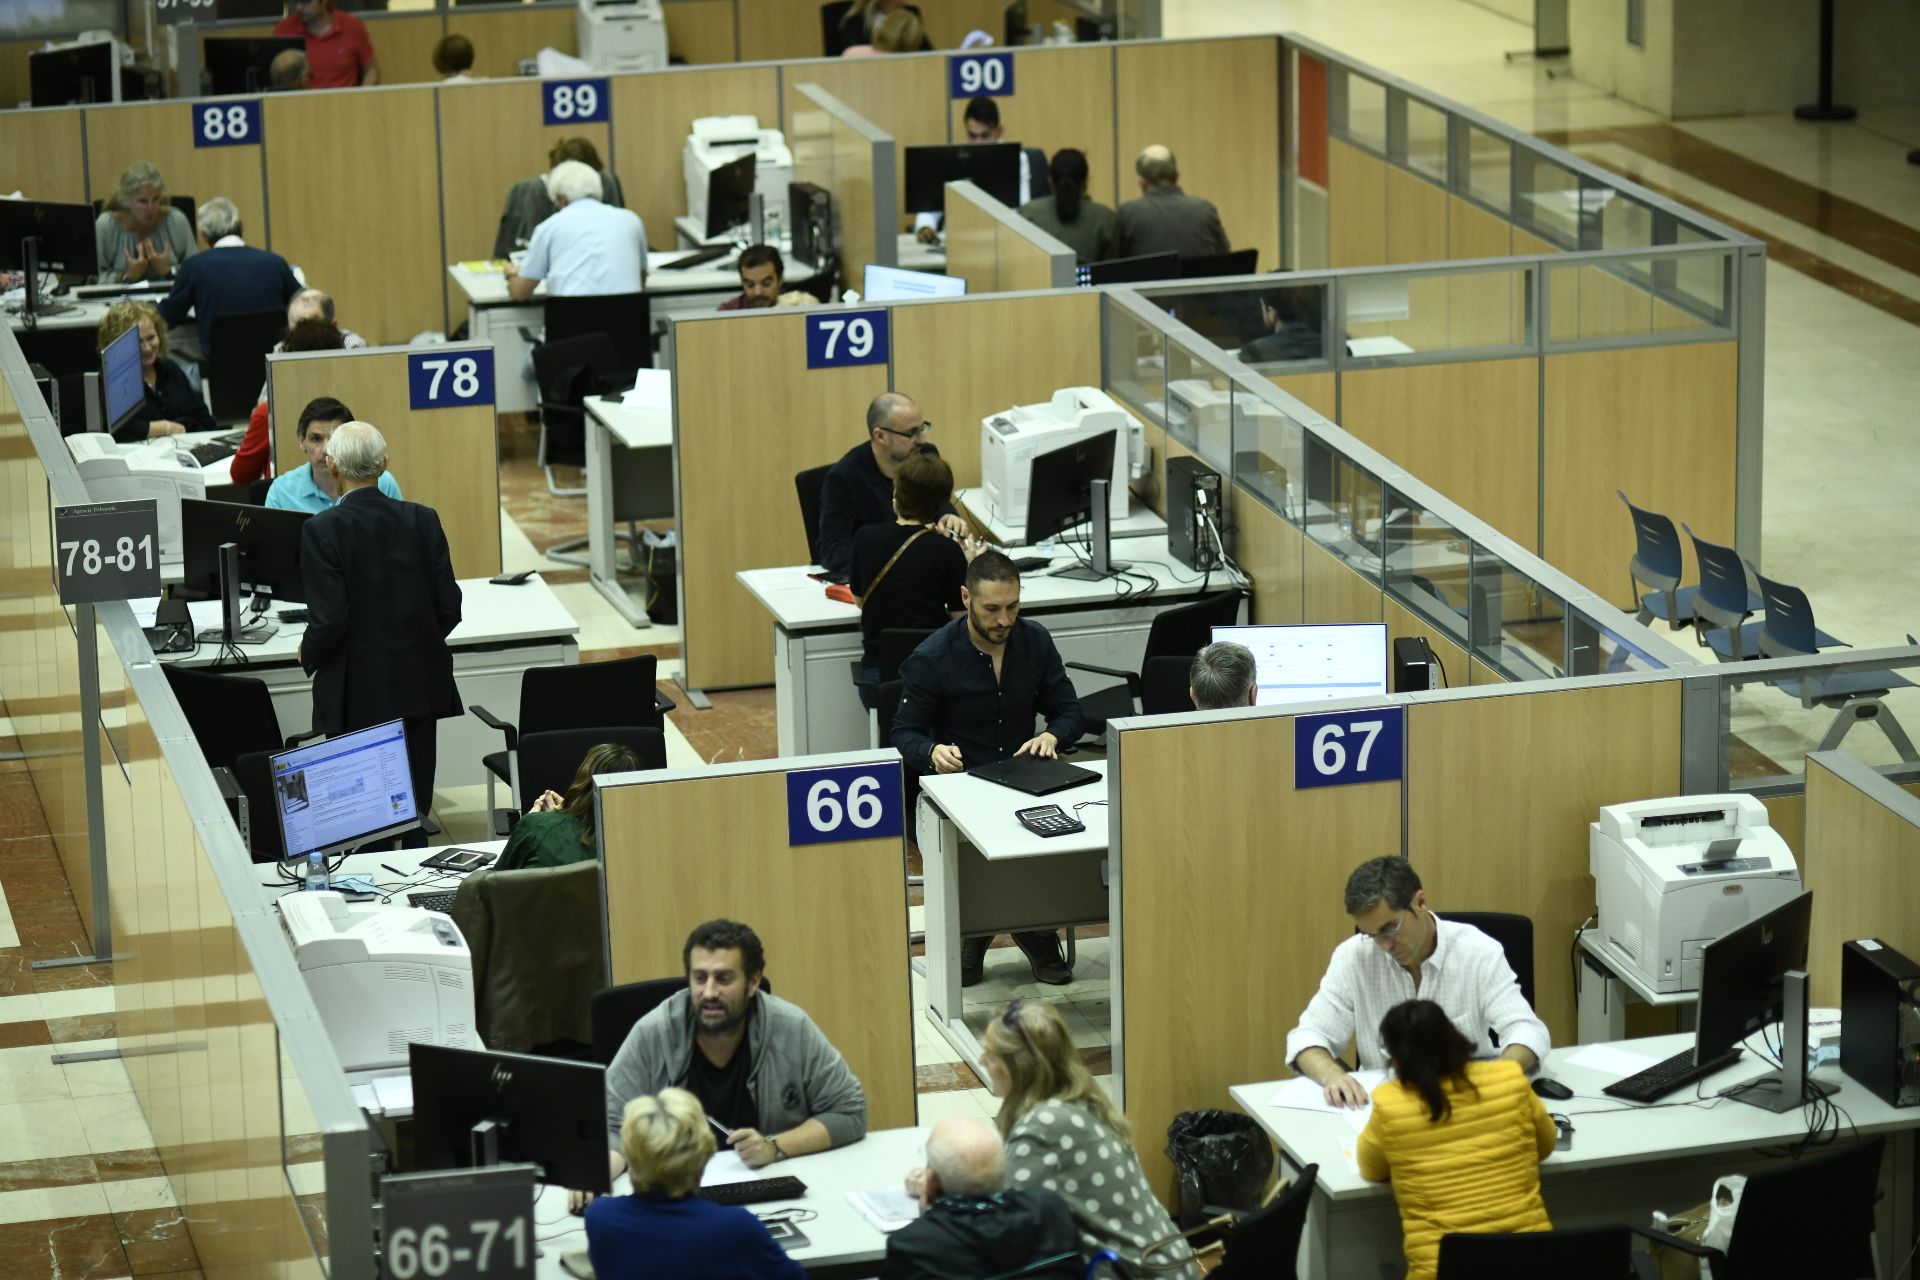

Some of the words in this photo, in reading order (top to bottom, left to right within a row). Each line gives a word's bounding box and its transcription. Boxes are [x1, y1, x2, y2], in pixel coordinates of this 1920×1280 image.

[960, 58, 1005, 92] 90
[203, 105, 249, 140] 88
[553, 84, 598, 119] 89
[819, 317, 874, 359] 79
[422, 357, 480, 400] 78
[60, 534, 153, 577] 78-81
[1312, 720, 1383, 776] 67
[806, 776, 883, 832] 66
[388, 1217, 526, 1279] 66-71
